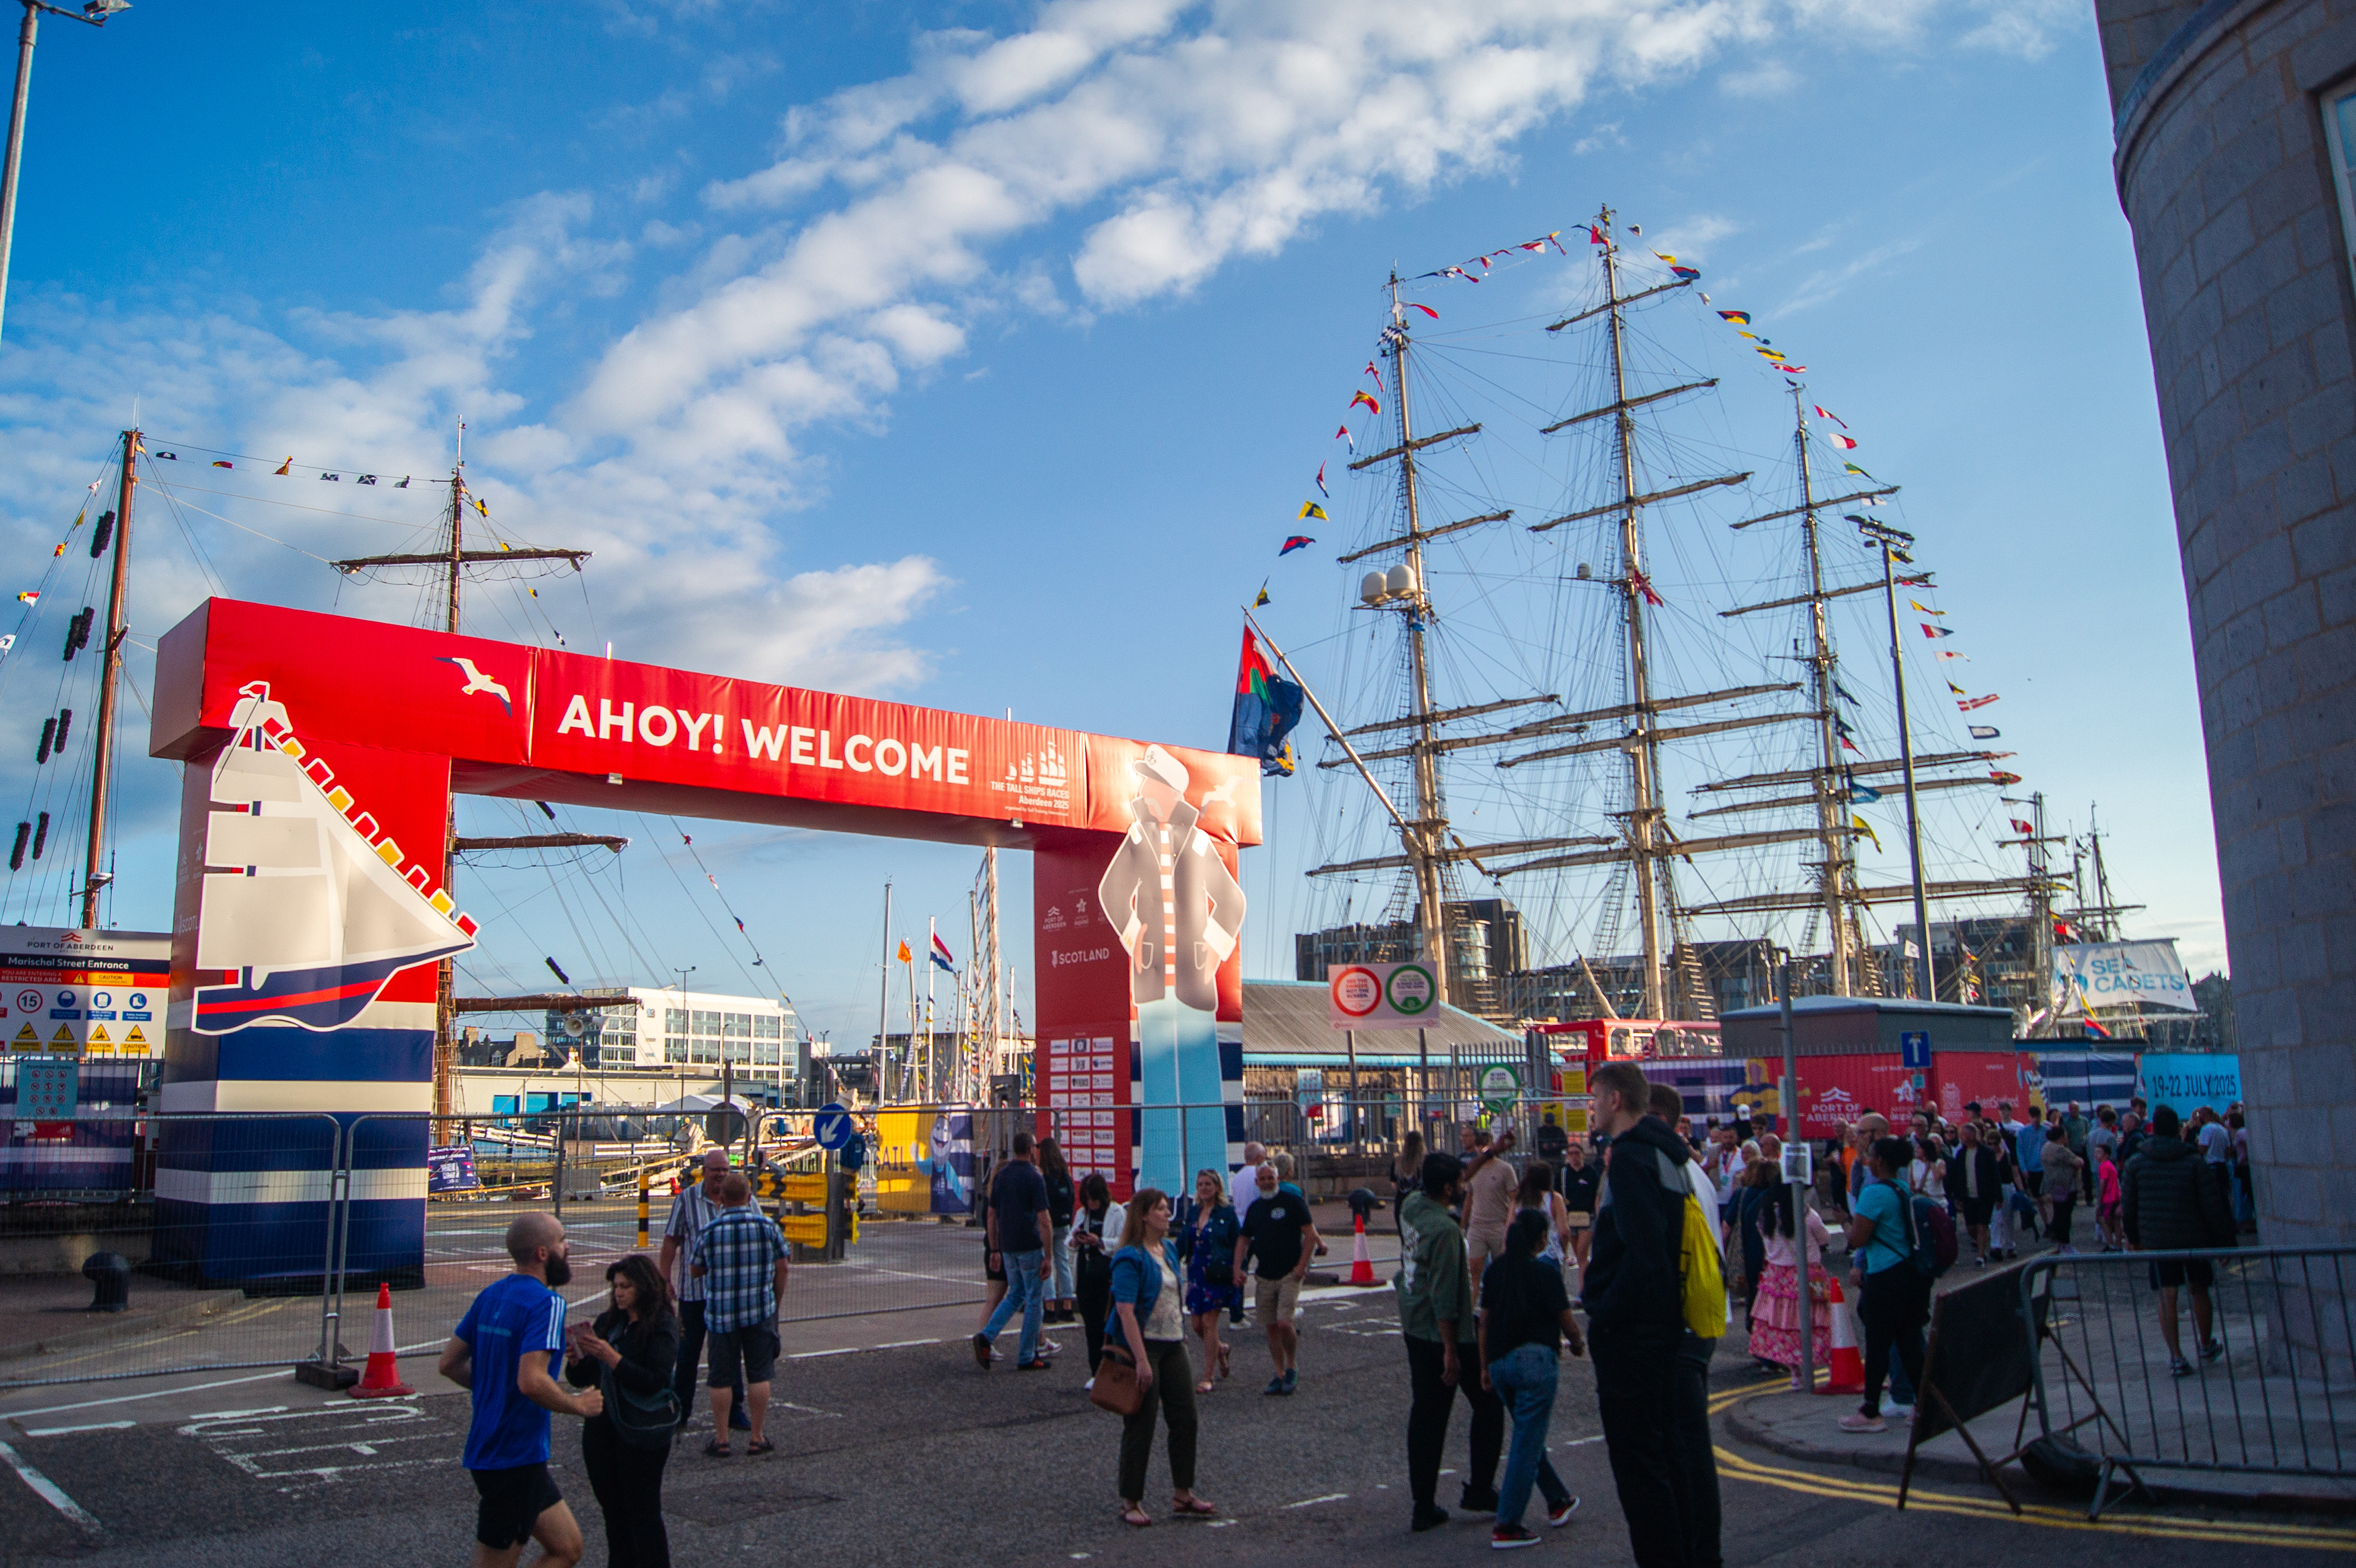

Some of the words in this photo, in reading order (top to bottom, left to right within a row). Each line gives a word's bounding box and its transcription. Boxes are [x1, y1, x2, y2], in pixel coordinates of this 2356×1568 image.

[557, 694, 724, 755] AHOY!
[741, 718, 969, 785] WELCOME
[990, 780, 1005, 791] THE
[1006, 783, 1023, 794] TALL
[1023, 785, 1045, 797] SHIPS
[1046, 788, 1069, 799] RACES
[1018, 795, 1053, 807] Aberdeen
[1053, 799, 1069, 810] 2025
[8, 956, 55, 966] Marischal
[57, 959, 86, 968] Street
[88, 959, 129, 969] Entrance
[1058, 948, 1110, 965] SCOTLAND
[2091, 958, 2137, 975] SEA
[2095, 974, 2185, 993] CADETS
[21, 995, 37, 1007] 15
[2152, 1075, 2182, 1098] 19-22
[2185, 1075, 2212, 1097] JULY
[2214, 1074, 2236, 1096] 2025
[1811, 1103, 1843, 1113] PORT
[1845, 1103, 1861, 1113] OF
[1806, 1112, 1861, 1123] ABERDEE
